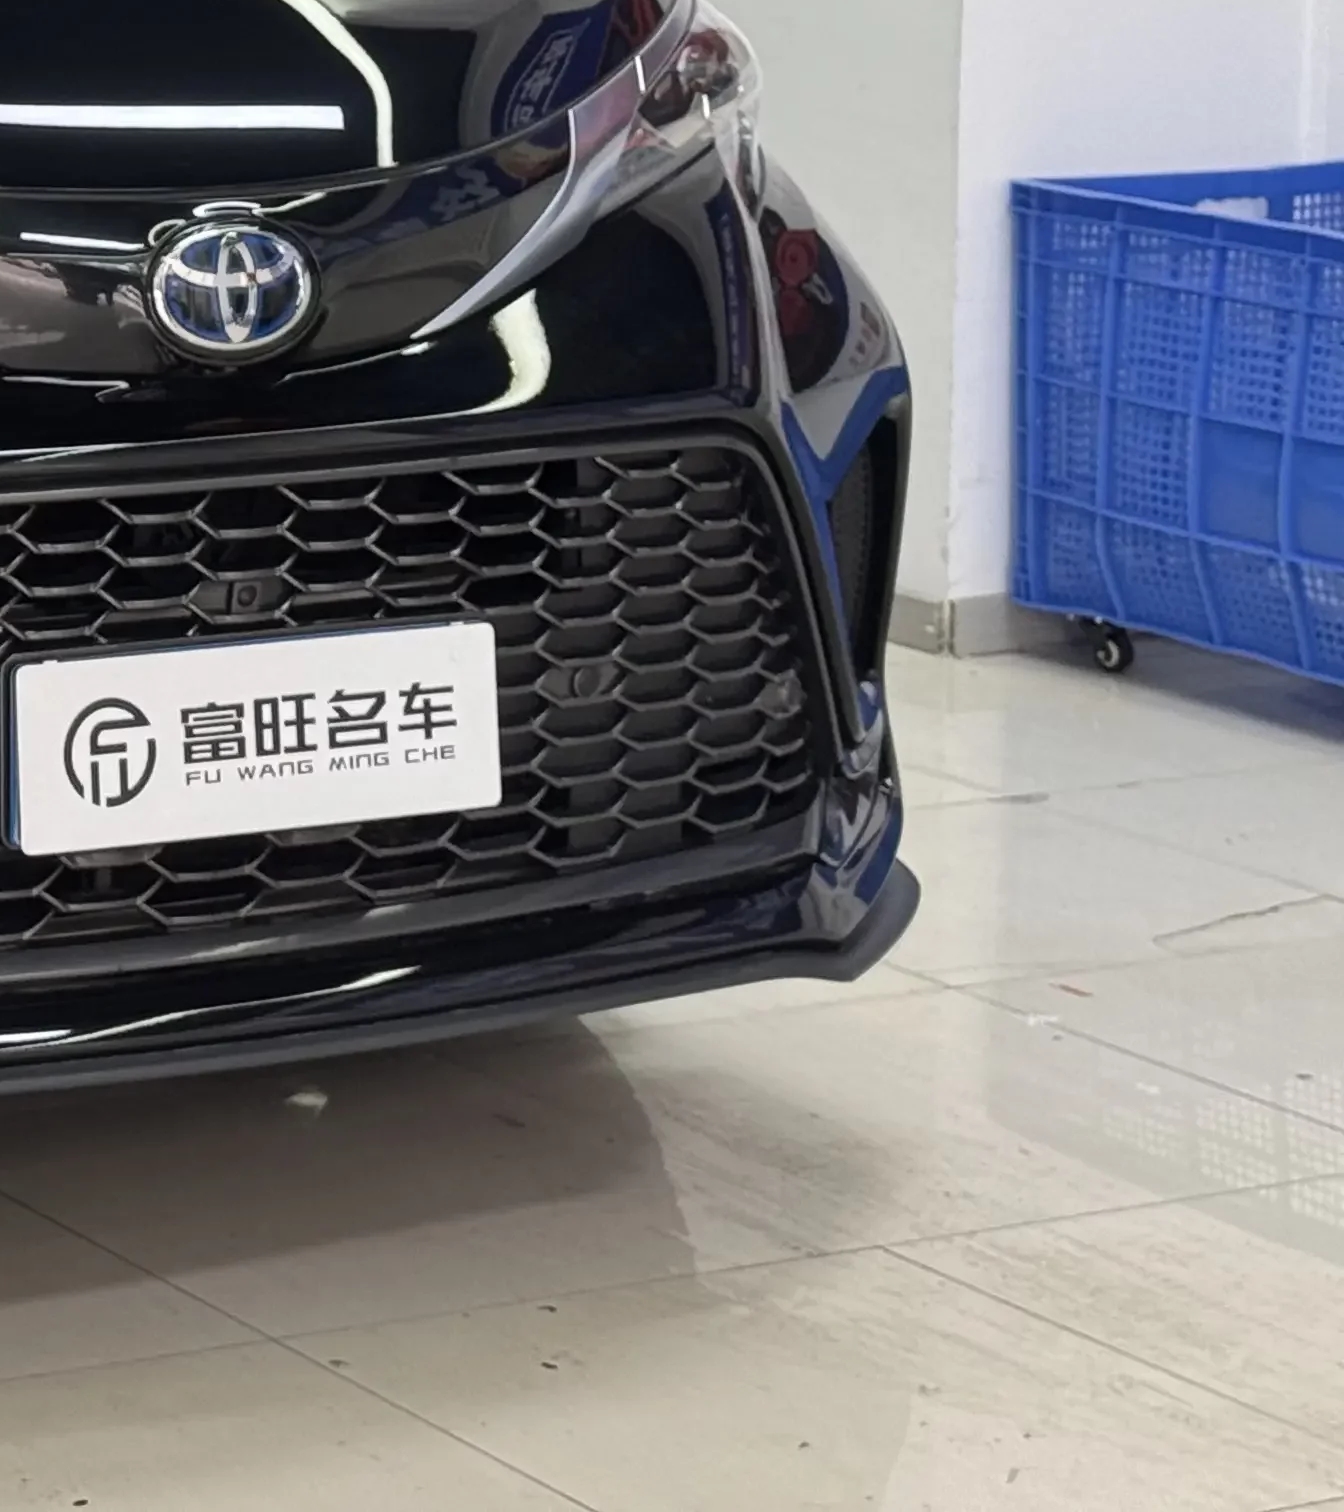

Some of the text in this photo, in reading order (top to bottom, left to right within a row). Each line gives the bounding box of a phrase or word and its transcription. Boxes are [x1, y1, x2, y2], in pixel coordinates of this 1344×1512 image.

[180, 681, 459, 765] 富旺名车
[185, 744, 457, 787] FU WANG MING CHE
